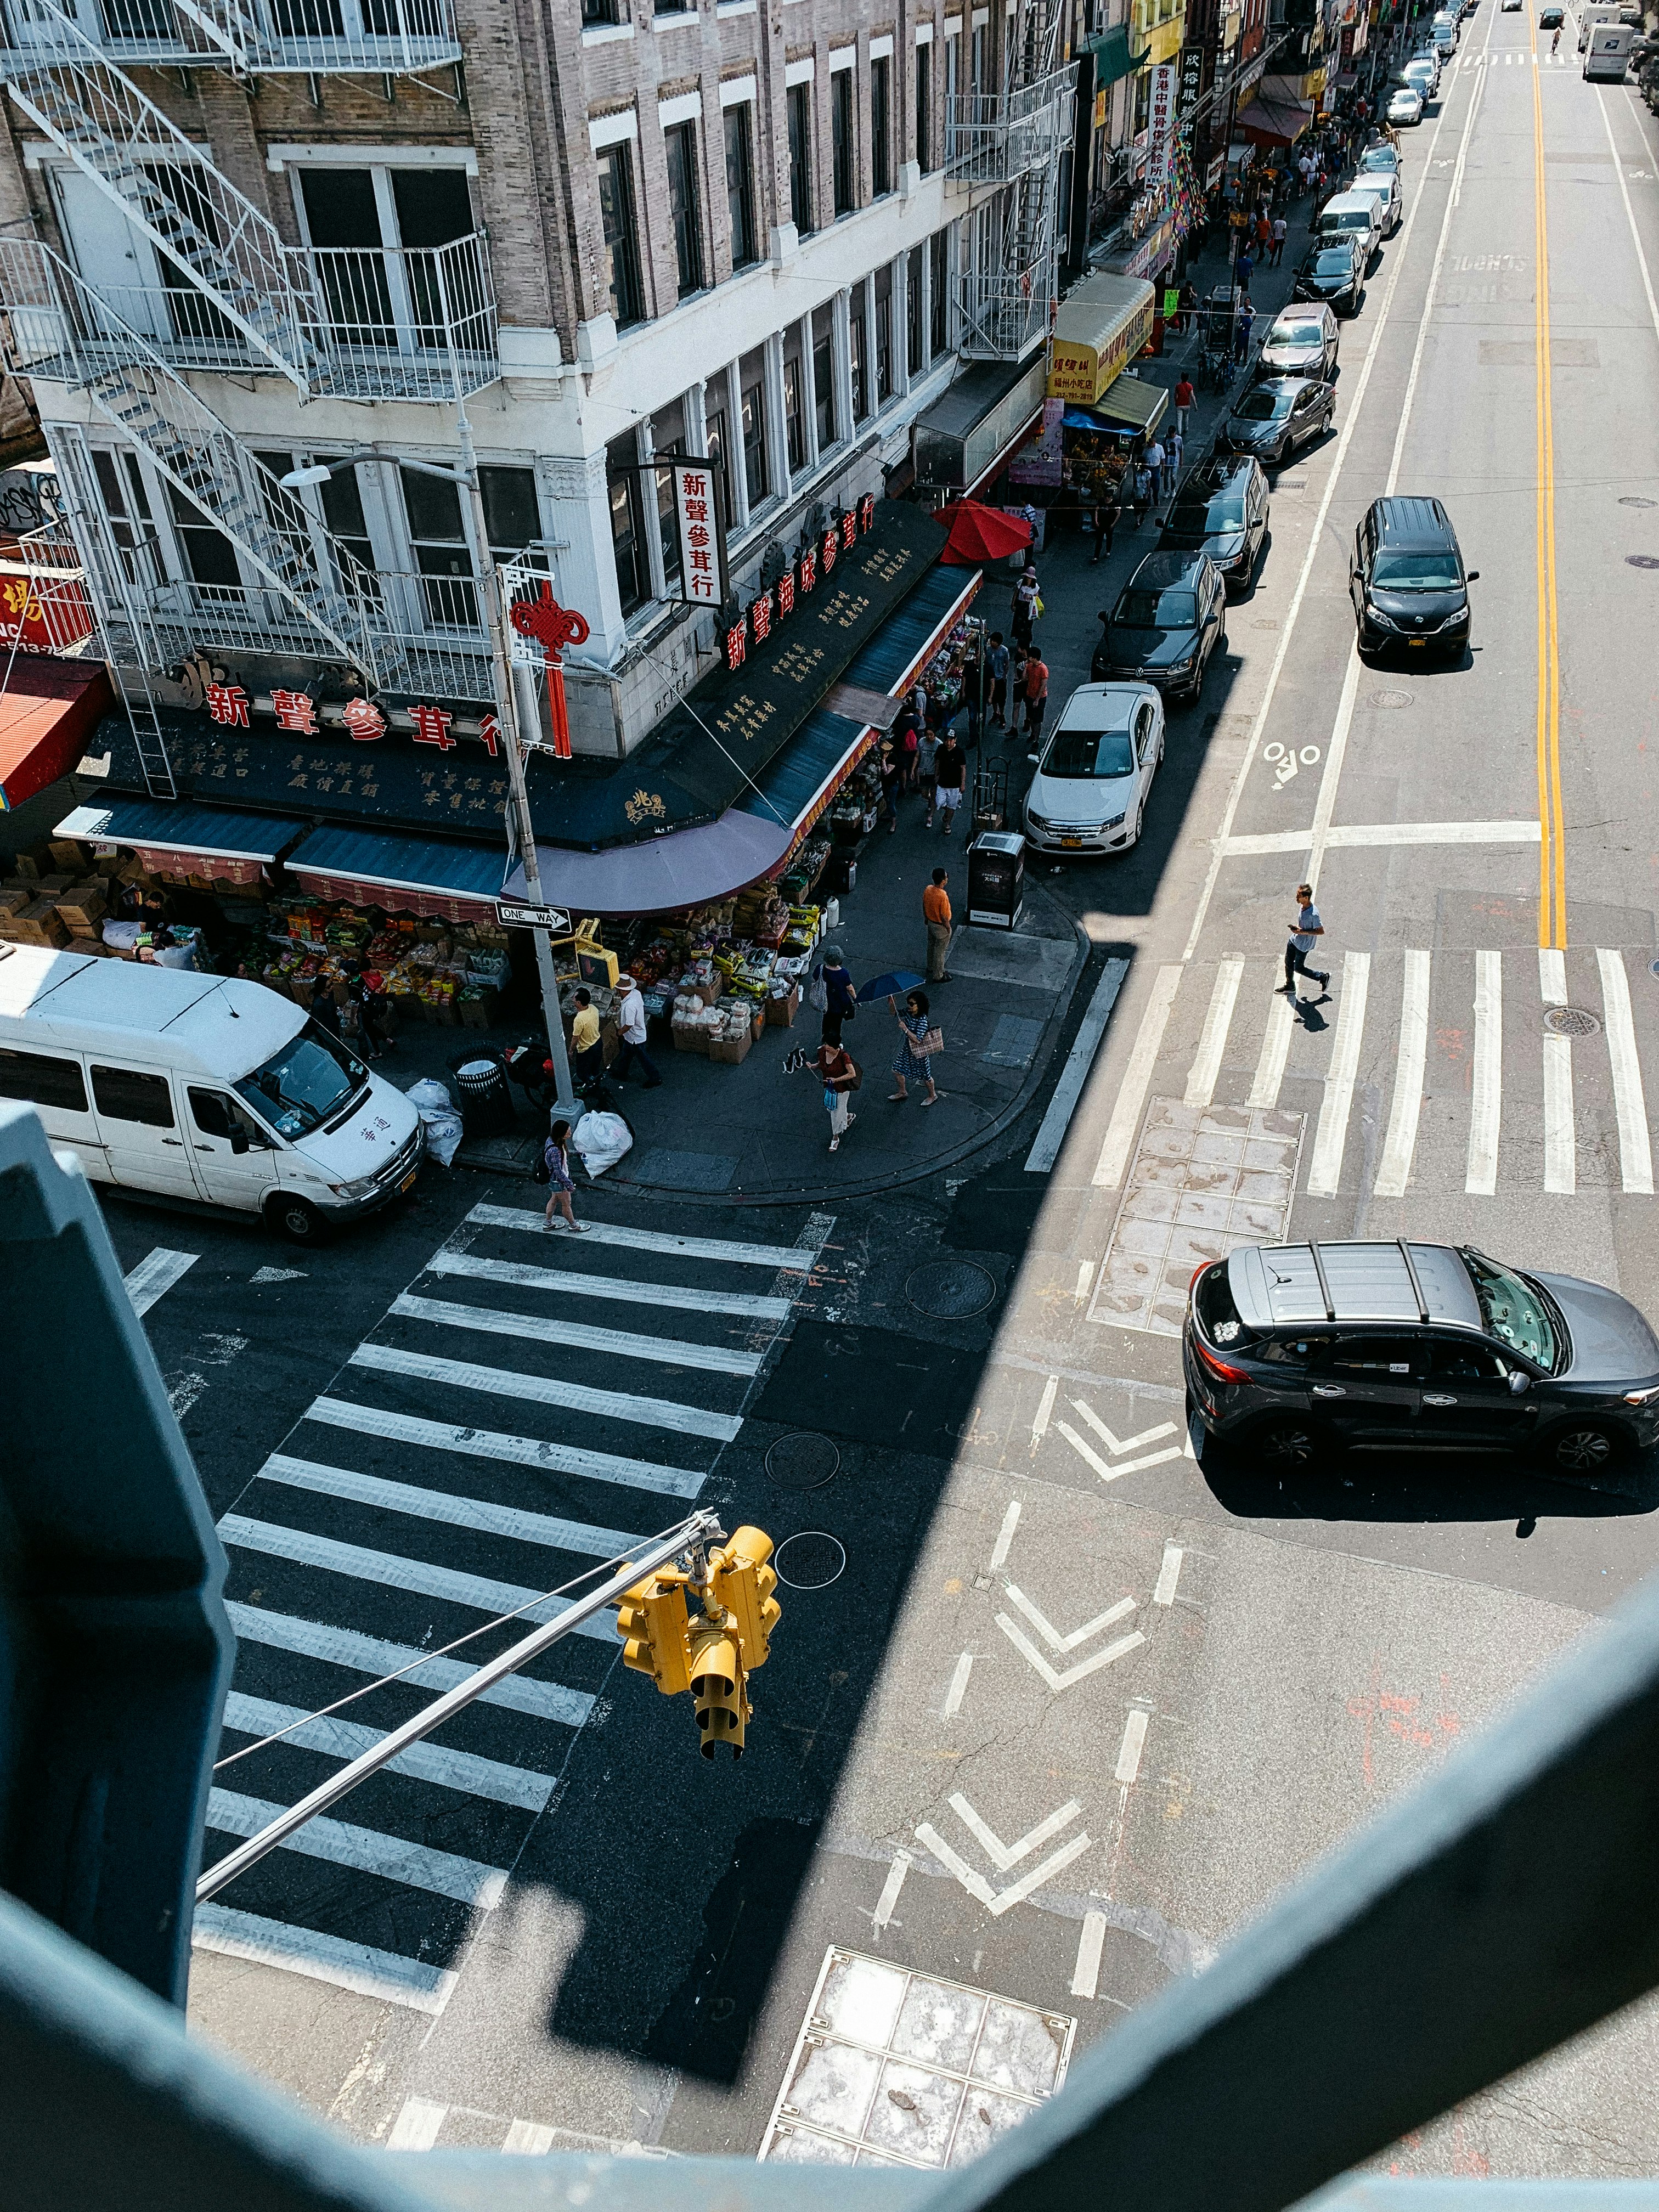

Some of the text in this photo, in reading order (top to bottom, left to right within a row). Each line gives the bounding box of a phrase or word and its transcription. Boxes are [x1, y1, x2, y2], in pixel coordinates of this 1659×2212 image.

[682, 473, 714, 597] 新聲參茸行
[504, 909, 559, 924] ONE WAY
[360, 1116, 391, 1141] 華通
